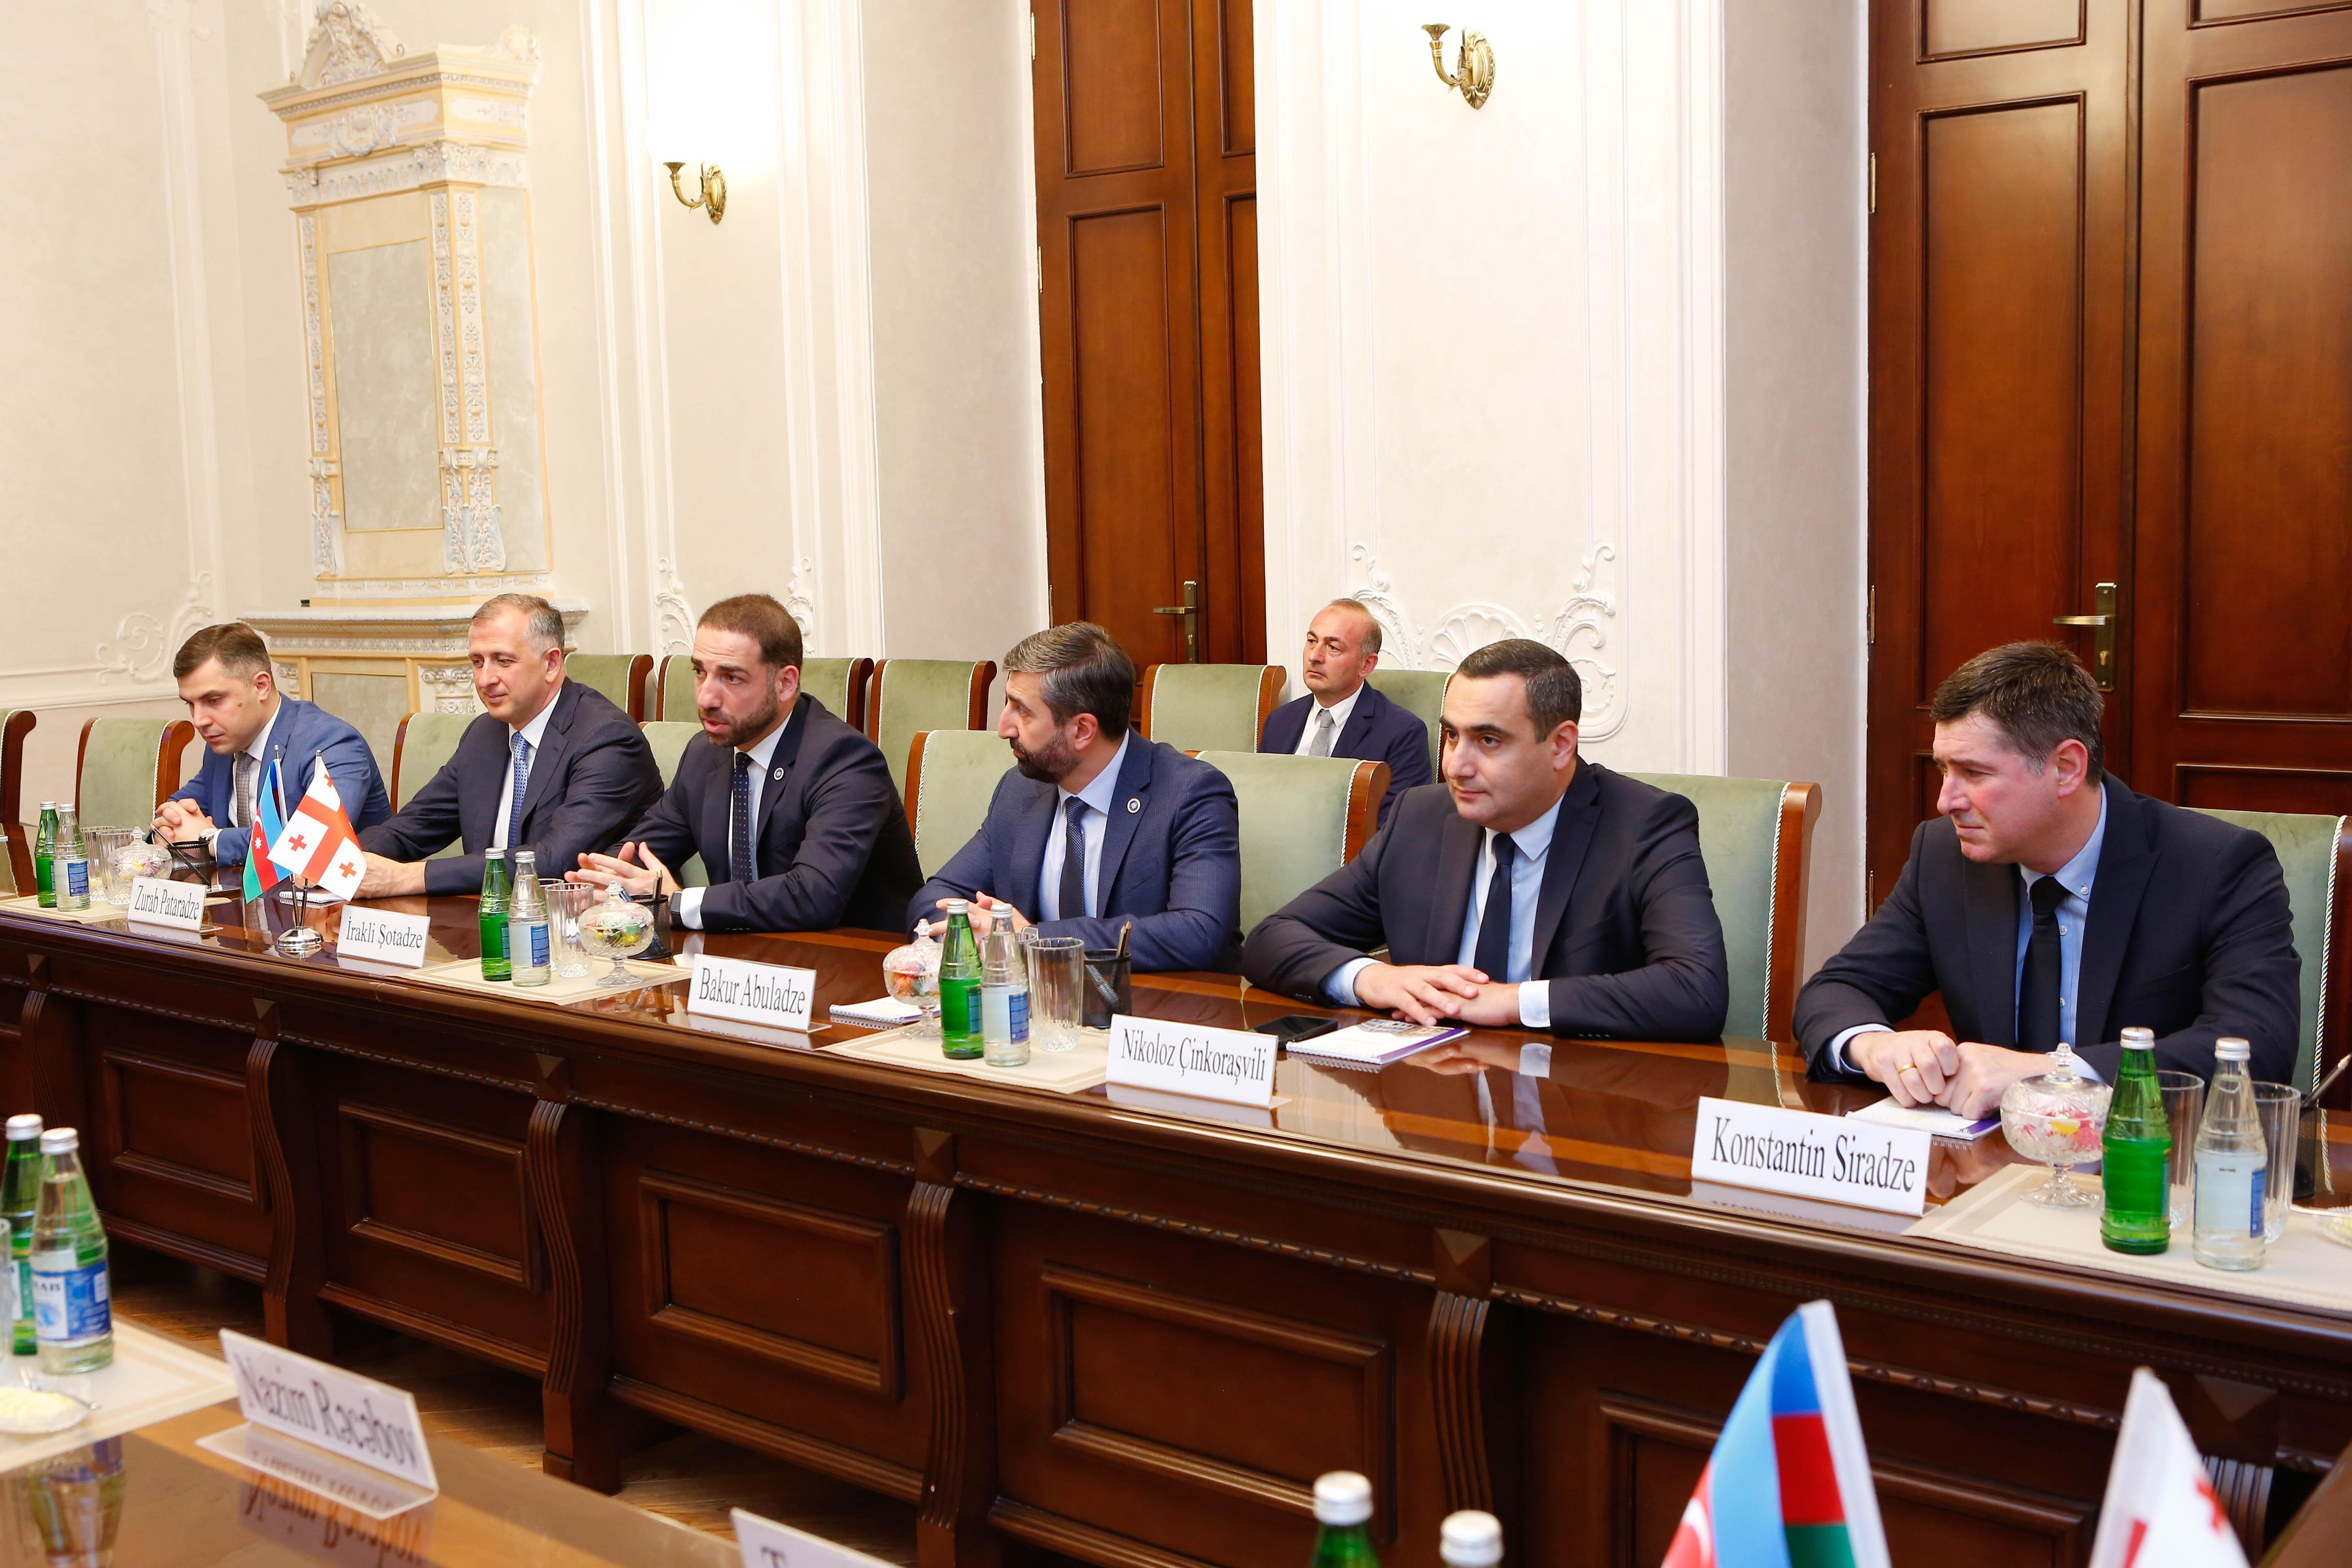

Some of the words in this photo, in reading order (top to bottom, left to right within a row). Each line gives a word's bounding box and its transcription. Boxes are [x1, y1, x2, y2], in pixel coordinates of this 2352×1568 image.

[134, 885, 159, 913] Zurab
[159, 889, 199, 920] Pataradze
[346, 916, 376, 943] İrakli
[378, 924, 422, 949] Şotadze
[699, 968, 739, 1004] Bakur
[740, 975, 805, 1014] Abuladze
[1121, 1029, 1176, 1066] Nikoloz
[1179, 1038, 1266, 1085] Çinkoraşvili
[1711, 1117, 1825, 1178] Konstantin
[1833, 1134, 1915, 1192] Siradze
